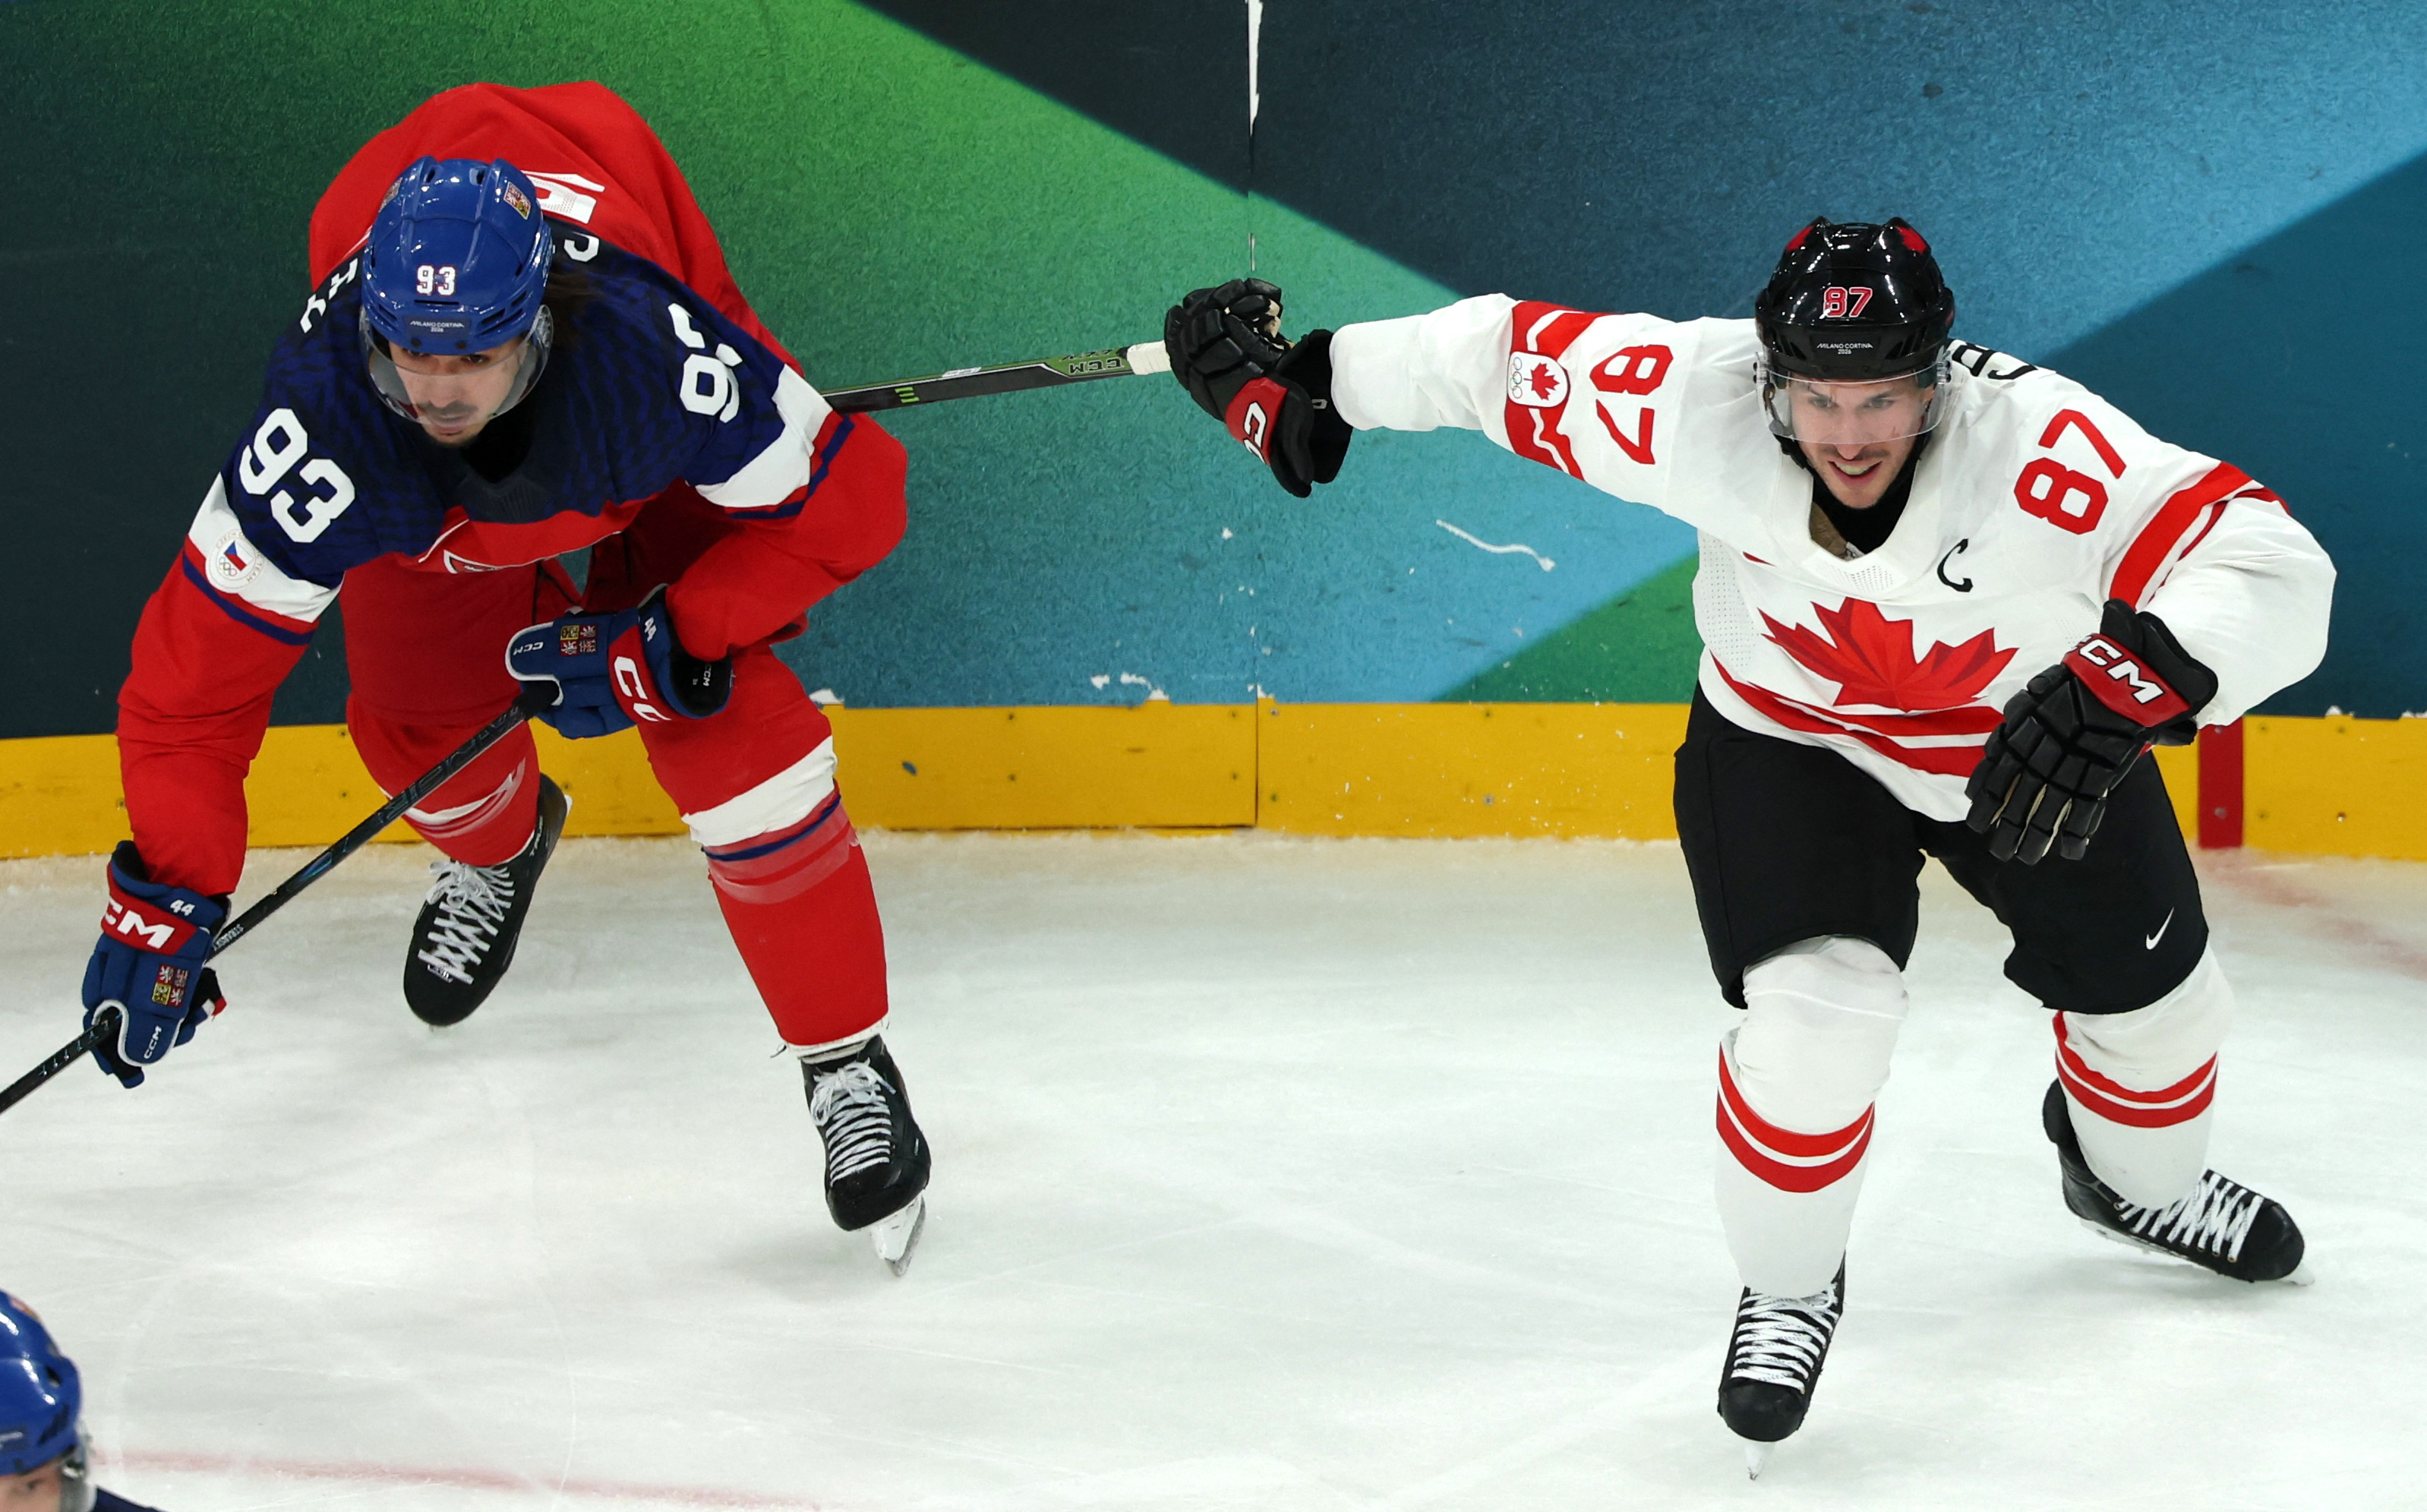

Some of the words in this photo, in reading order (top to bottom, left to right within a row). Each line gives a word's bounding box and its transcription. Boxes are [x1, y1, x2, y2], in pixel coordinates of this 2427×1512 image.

[415, 264, 456, 297] 93
[1823, 286, 1873, 317] 87
[1068, 356, 1125, 375] CCM
[1589, 344, 1674, 465] 87
[239, 408, 355, 543] 93
[2014, 409, 2126, 535] 87
[1937, 538, 1973, 592] C
[513, 641, 544, 656] CCM
[2076, 633, 2164, 705] CM
[105, 895, 175, 950] CM
[170, 899, 196, 917] 44
[144, 1025, 163, 1059] CCM
